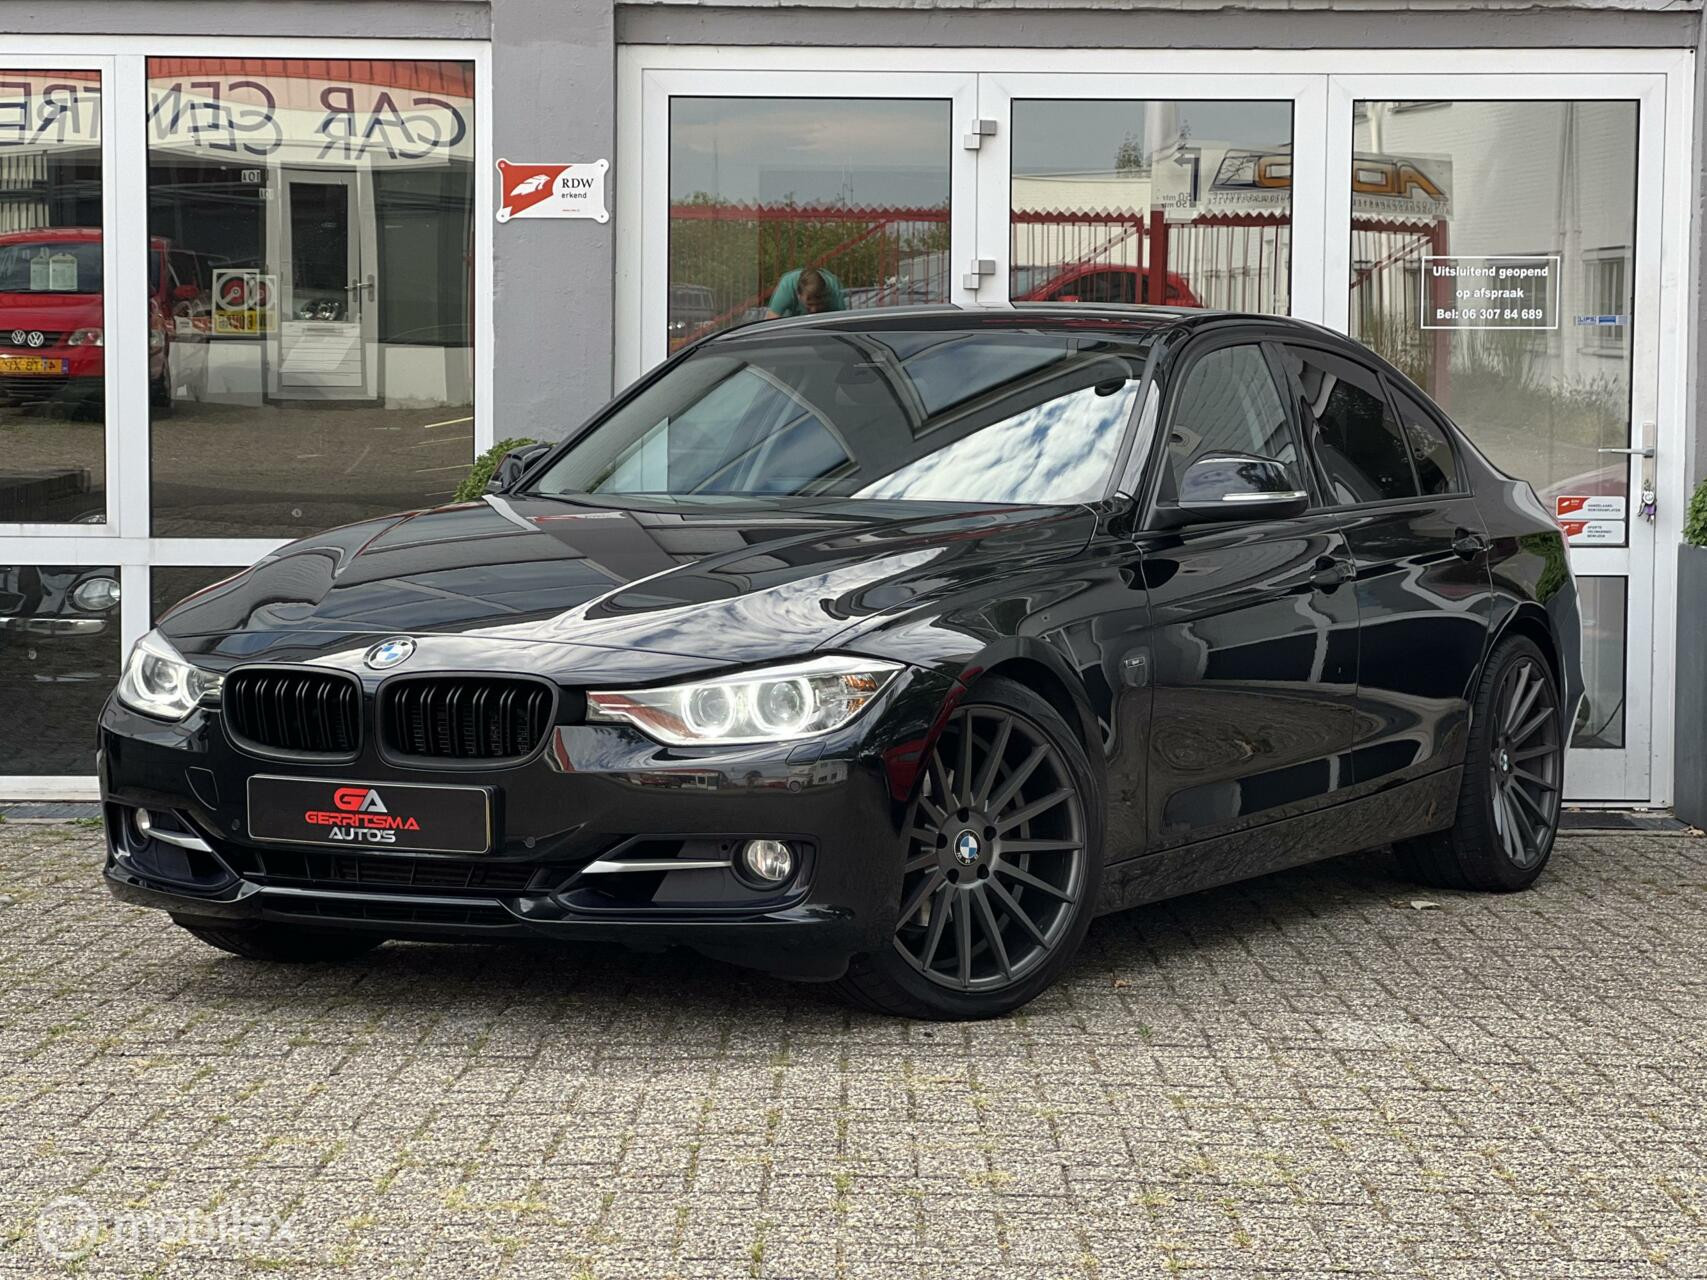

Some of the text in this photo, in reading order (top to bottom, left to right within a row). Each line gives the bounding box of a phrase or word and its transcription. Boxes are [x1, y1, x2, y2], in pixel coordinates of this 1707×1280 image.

[561, 178, 594, 189] RDW
[561, 191, 587, 199] erkend
[1433, 266, 1549, 279] Uitsluitend geopend
[1456, 288, 1524, 299] op afspraak
[1436, 309, 1543, 319] Bel: 06 307 84 689
[333, 787, 388, 813] GA
[304, 811, 420, 831] GERRITSMA
